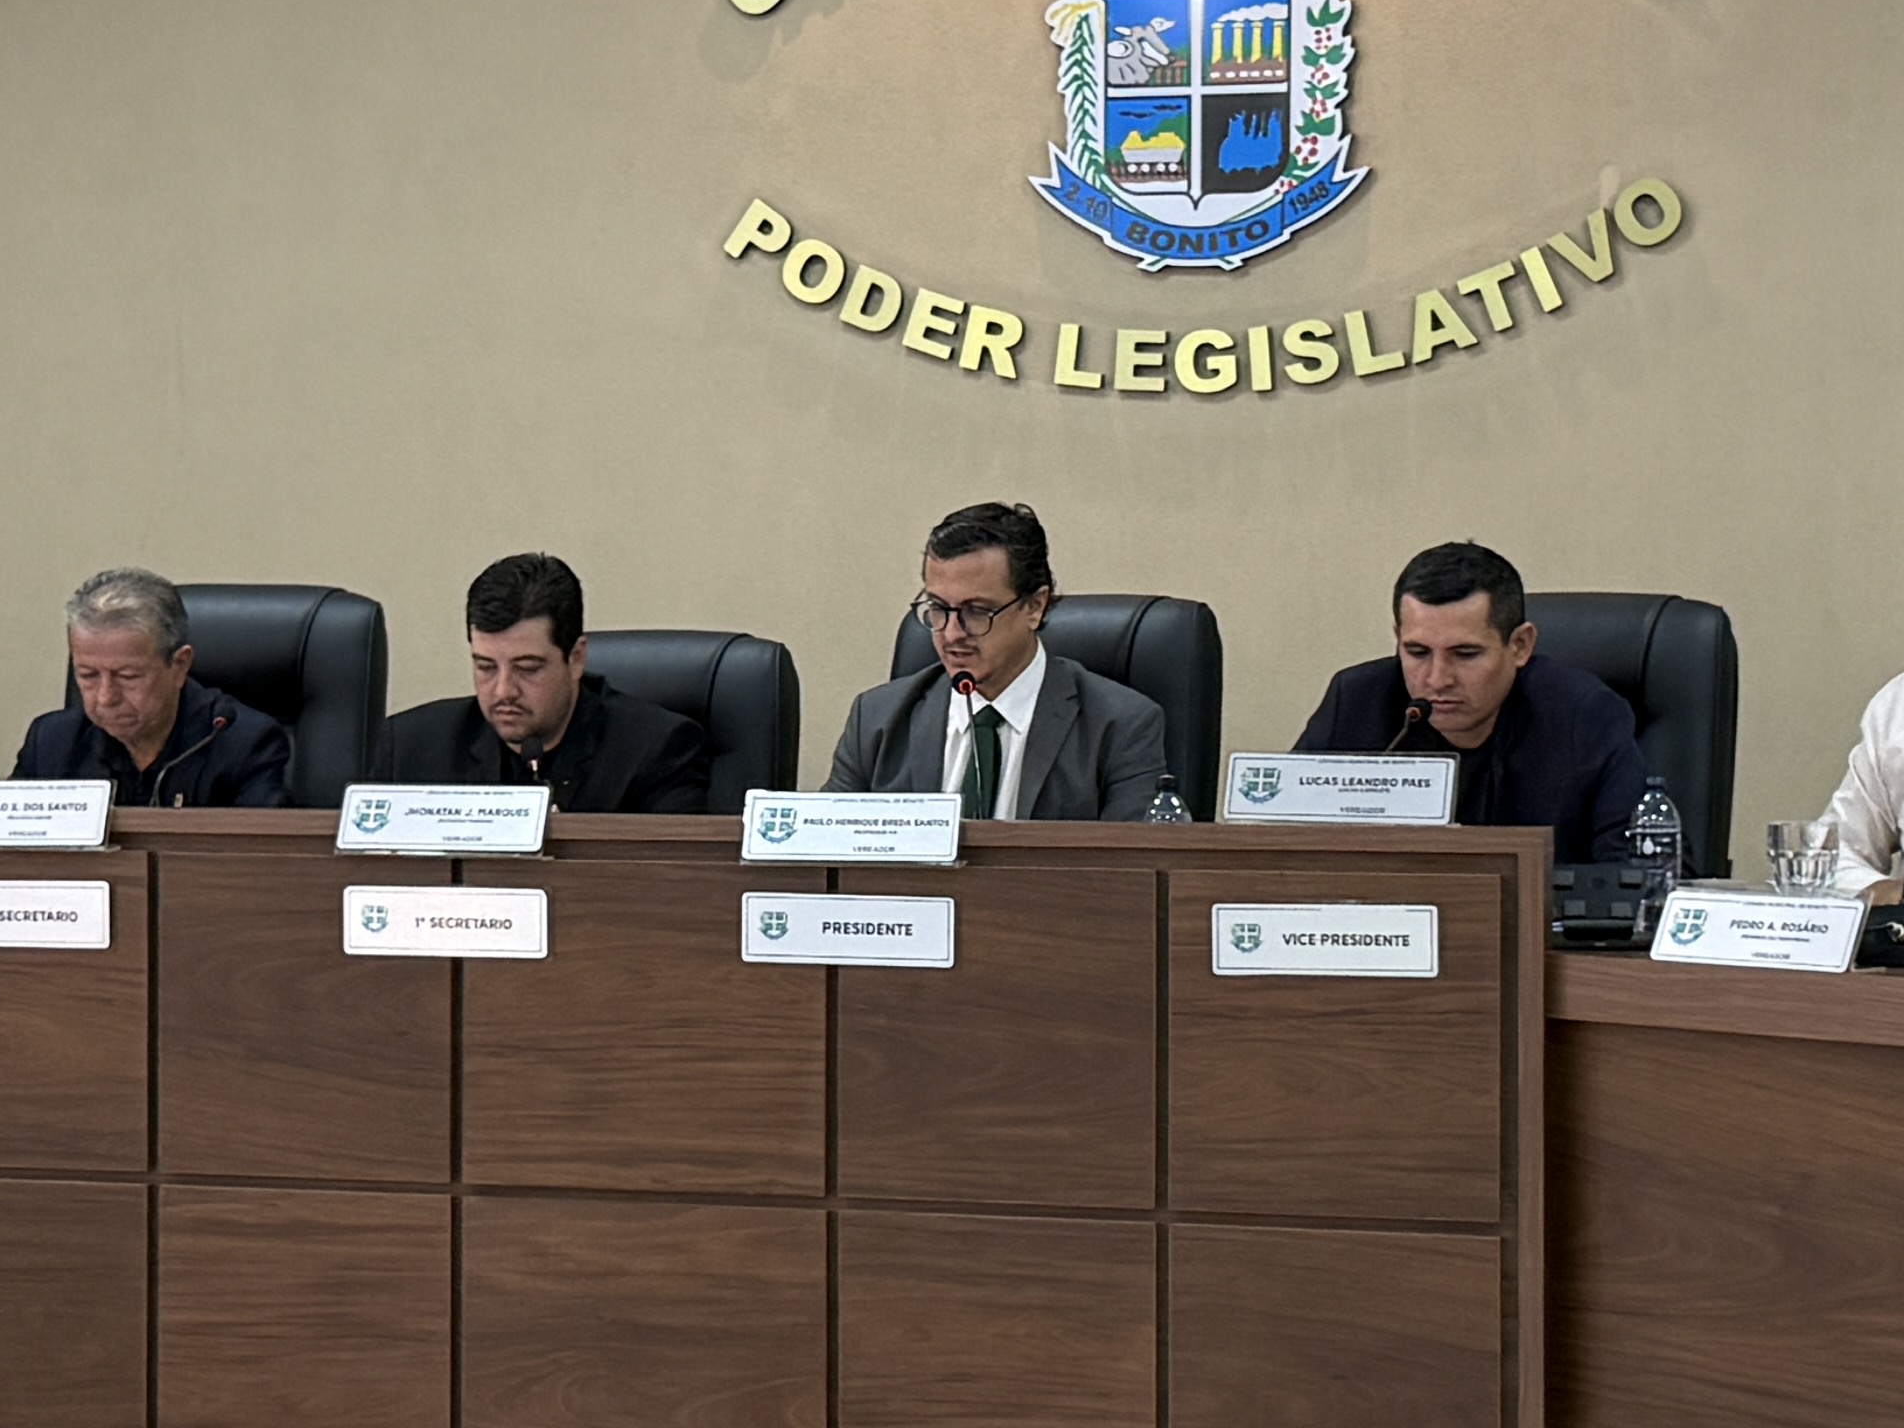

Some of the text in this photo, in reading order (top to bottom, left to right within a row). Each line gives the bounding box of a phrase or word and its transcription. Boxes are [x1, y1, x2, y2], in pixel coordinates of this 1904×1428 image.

[1125, 220, 1270, 255] BONITO
[721, 175, 1684, 395] PODER LEGISLATIVO
[1299, 776, 1431, 788] LUCAS LEANDRO PAES
[478, 808, 530, 817] MARQUES
[822, 922, 914, 937] PRESIDENTE
[1729, 919, 1765, 931] PEDRO
[1780, 920, 1829, 934] ROSÁRIO
[1282, 933, 1410, 947] VICE PRESIDENTE
